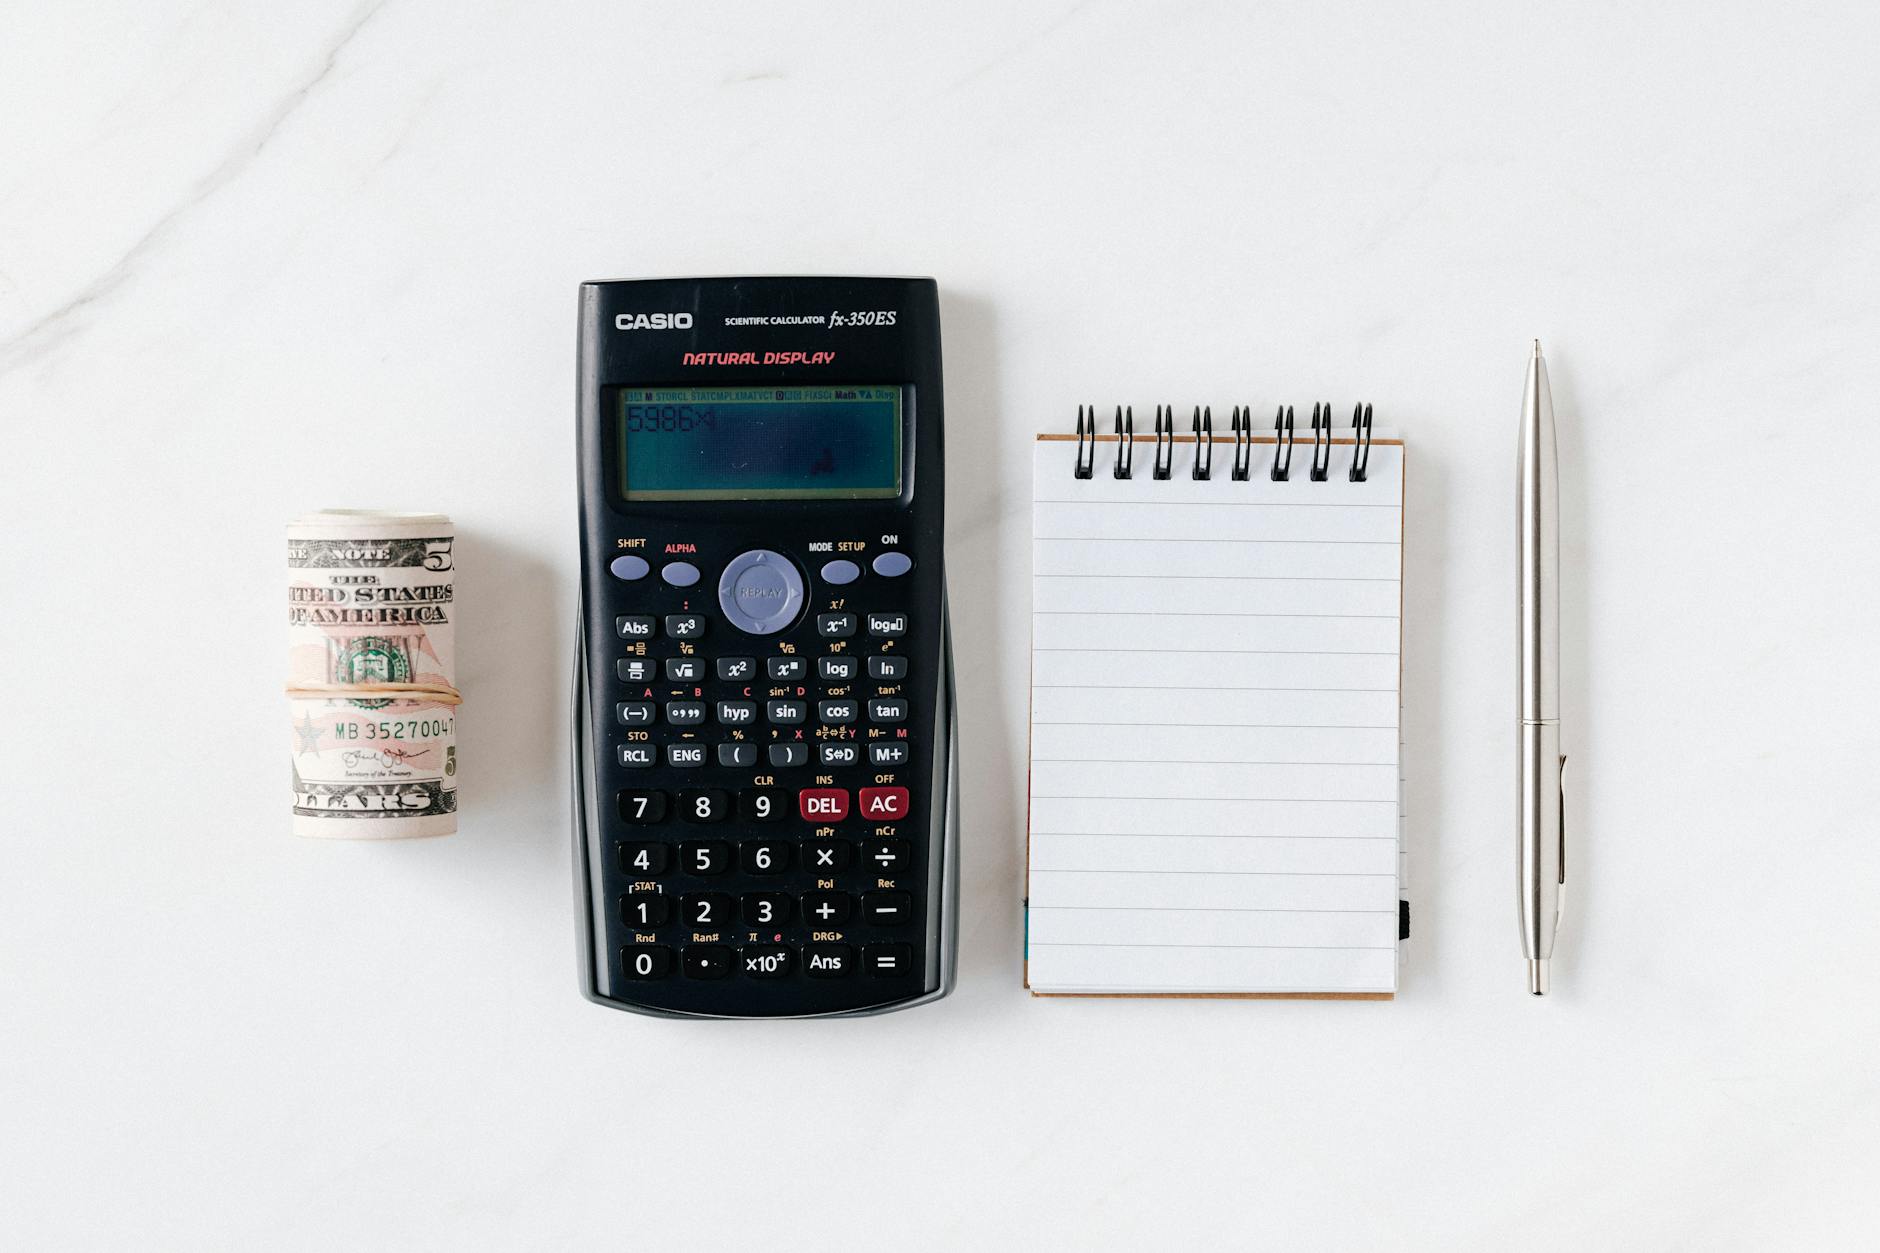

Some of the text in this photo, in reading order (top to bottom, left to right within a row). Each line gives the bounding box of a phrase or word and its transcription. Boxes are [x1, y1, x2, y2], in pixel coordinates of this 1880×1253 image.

[616, 313, 693, 329] CASIO
[725, 311, 896, 329] SCIENTIFIC CALCULATOR fx-350ES
[683, 352, 835, 365] NATURAL DISPLAY
[835, 390, 857, 400] Math
[618, 539, 646, 547] SHIFT
[882, 535, 897, 544] ON
[665, 544, 696, 552] ALPHA
[809, 542, 865, 551] MODE SETUP
[332, 549, 391, 560] NOTE
[422, 541, 454, 572] 5
[353, 584, 453, 606] STATES
[740, 587, 782, 598] REPLAY
[309, 606, 449, 627] AMERICA
[623, 622, 648, 634] Abs
[827, 662, 848, 677] log
[644, 688, 652, 697] A
[695, 688, 701, 696] B
[744, 688, 750, 696] C
[797, 687, 805, 695] D
[724, 705, 749, 720] hyp
[776, 705, 796, 717] sin
[827, 707, 849, 717] cos
[876, 706, 899, 716] tan
[336, 722, 359, 740] MB
[628, 732, 648, 740] STO
[733, 730, 743, 739] %
[796, 730, 802, 738] X
[897, 729, 906, 737] M
[624, 750, 649, 761] RCL
[673, 750, 700, 761] ENG
[876, 748, 902, 761] M+
[755, 776, 773, 785] CLR
[817, 776, 833, 784] INS
[875, 775, 894, 783] OFF
[634, 798, 647, 817] 7
[696, 797, 710, 817] 8
[756, 796, 770, 817] 9
[808, 798, 841, 813] DEL
[870, 796, 896, 812] AC
[816, 827, 834, 836] nPr
[876, 826, 895, 835] nCr
[634, 850, 649, 870] 4
[697, 849, 710, 869] 5
[756, 848, 771, 868] 6
[633, 882, 655, 890] STAT
[818, 879, 833, 888] Pol
[878, 879, 894, 887] Rec
[638, 903, 646, 923] 1
[697, 902, 711, 922] 2
[759, 901, 772, 922] 3
[636, 934, 655, 942] Rnd
[693, 934, 719, 942] Ran#
[636, 954, 652, 974] 0
[810, 955, 841, 969] Ans
